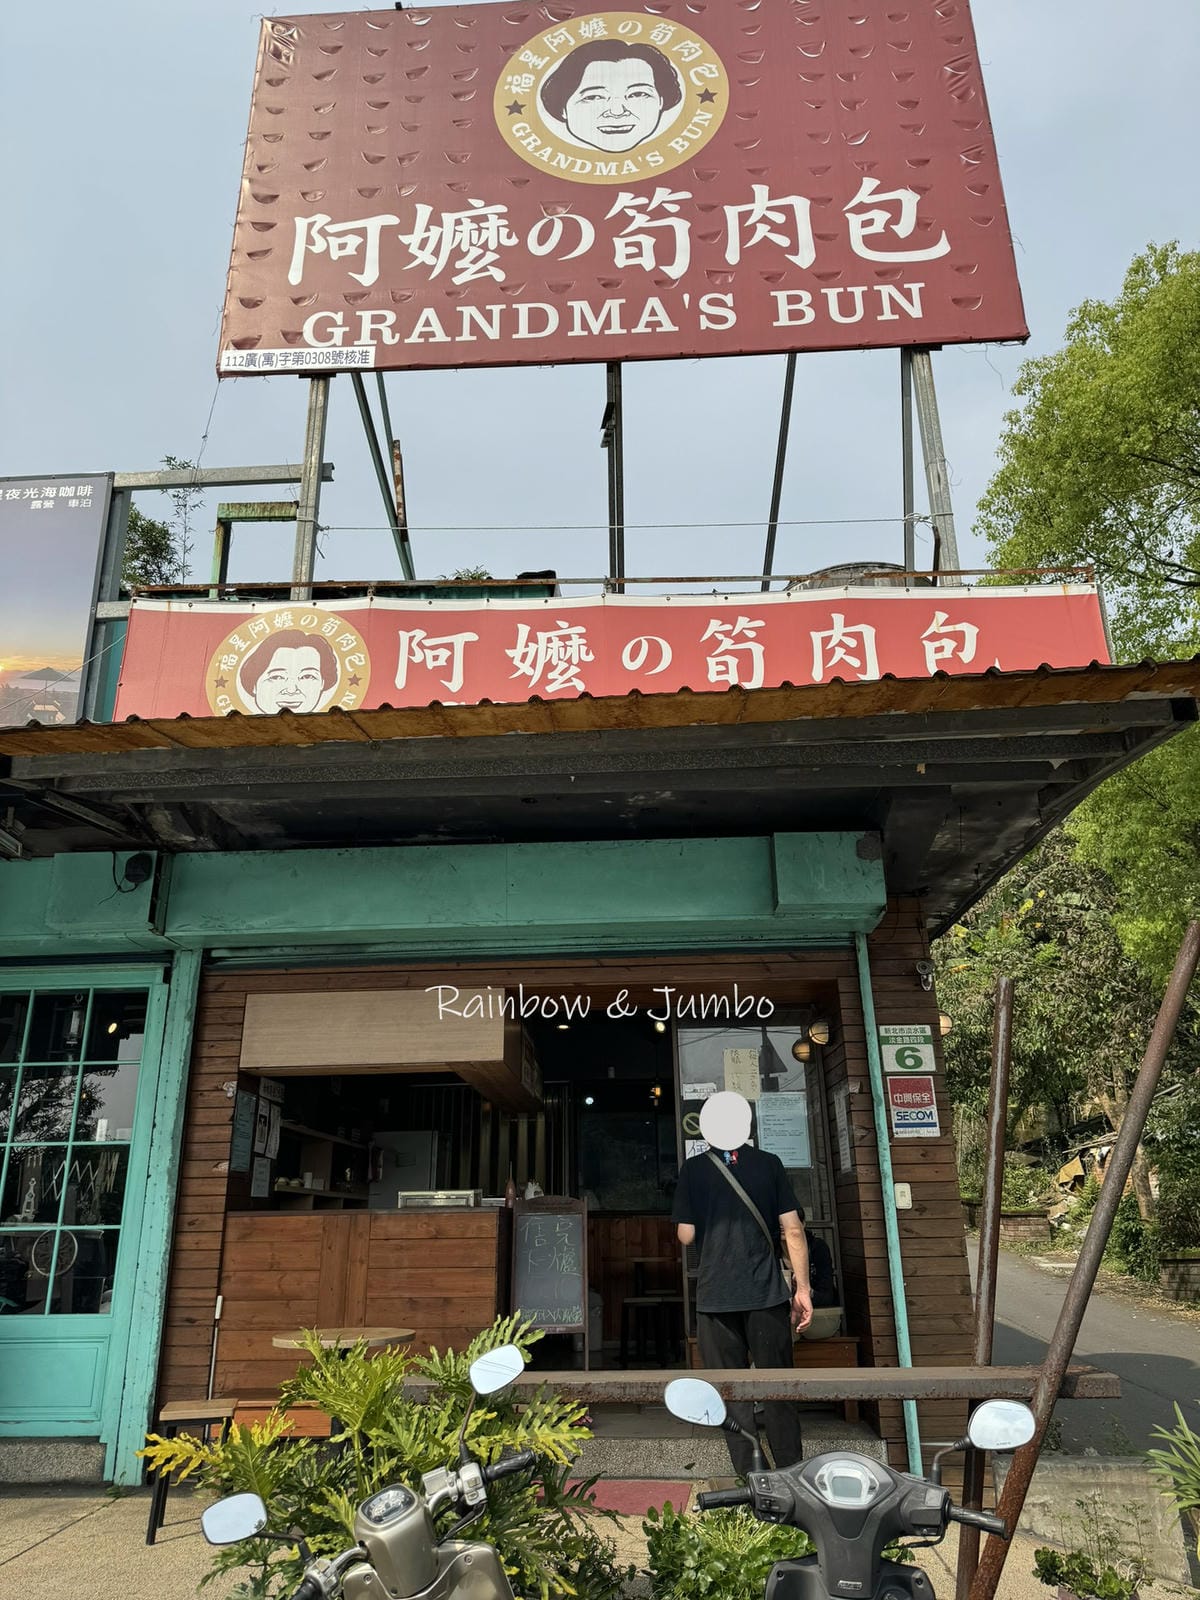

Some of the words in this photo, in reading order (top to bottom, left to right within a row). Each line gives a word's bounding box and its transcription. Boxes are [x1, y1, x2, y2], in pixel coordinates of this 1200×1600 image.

[511, 122, 665, 176] GRANDMA'S
[668, 109, 713, 154] BUN
[288, 177, 951, 287] 阿嬤の筍肉包
[302, 293, 738, 347] GRANDMA'S
[770, 283, 925, 327] BUN
[0, 485, 94, 500] 夜光海咖啡
[895, 1046, 923, 1070] 6
[893, 1092, 931, 1104] 中興保全
[896, 1110, 934, 1121] SECOM
